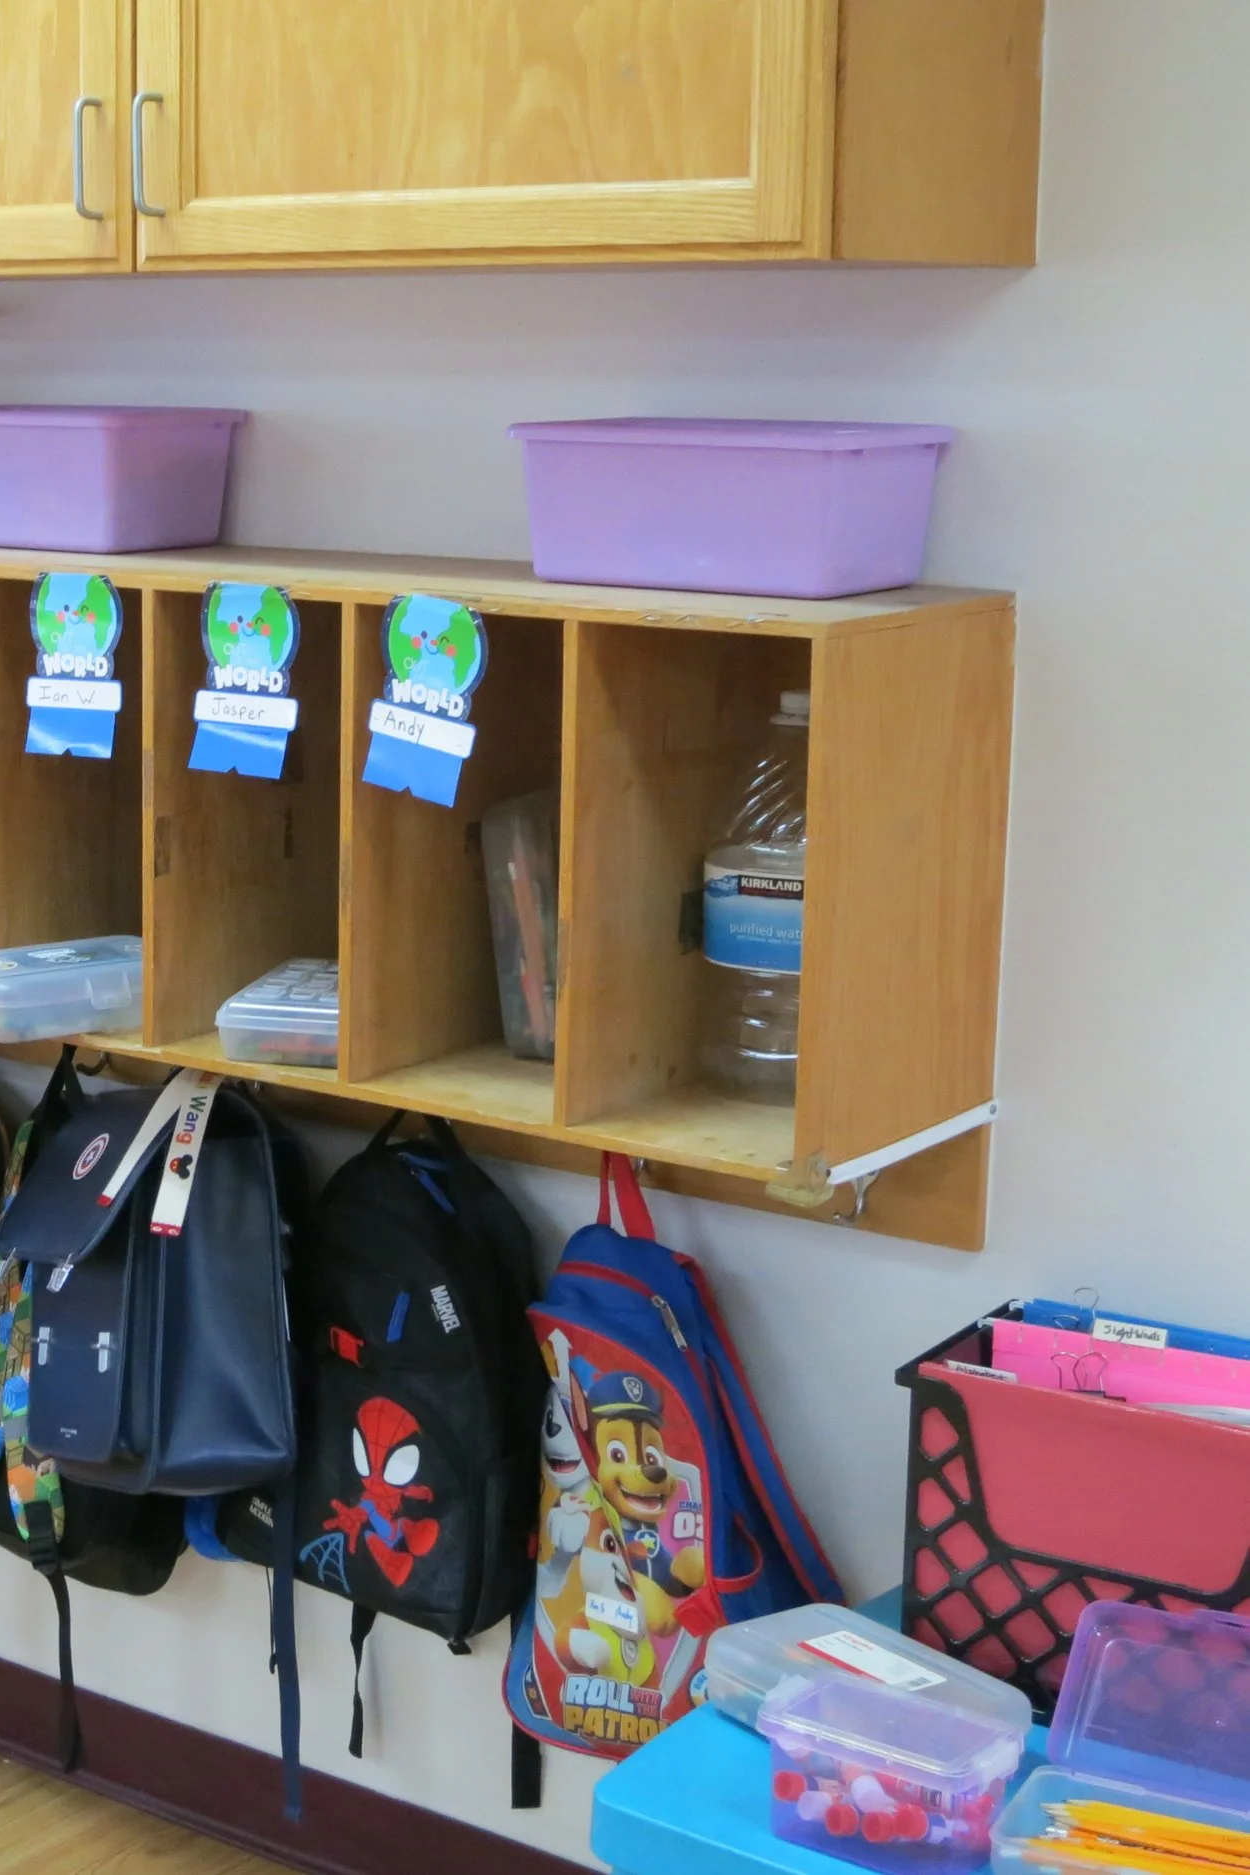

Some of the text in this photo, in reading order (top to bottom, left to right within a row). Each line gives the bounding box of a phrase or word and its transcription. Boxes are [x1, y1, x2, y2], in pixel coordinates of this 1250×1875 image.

[42, 652, 108, 678] WORLD
[213, 664, 283, 693] WORLD
[38, 685, 69, 702] Ian
[391, 678, 464, 718] WORLD
[212, 697, 266, 720] Jasper
[383, 710, 425, 744] Andy
[740, 877, 803, 892] KIRKLAND
[730, 923, 773, 937] purified
[176, 1096, 208, 1146] Wang
[430, 1285, 461, 1334] MARVEL
[565, 1675, 634, 1712] ROLL
